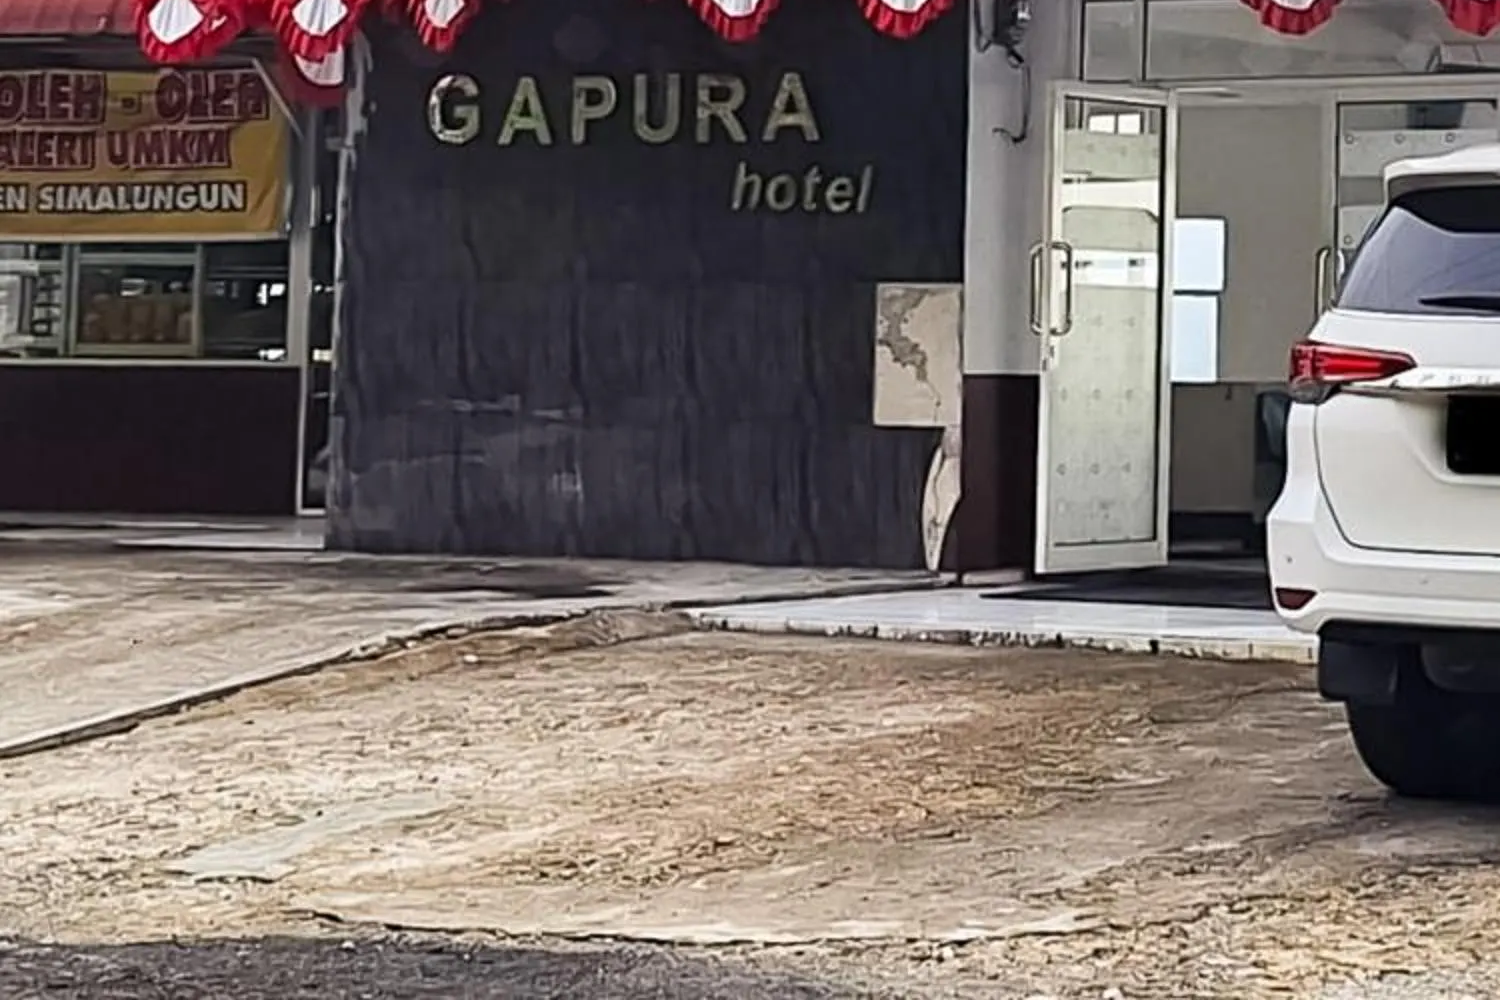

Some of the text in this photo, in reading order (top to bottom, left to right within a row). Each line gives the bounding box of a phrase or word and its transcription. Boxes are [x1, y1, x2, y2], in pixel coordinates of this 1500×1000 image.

[156, 72, 266, 119] OLEH
[428, 72, 821, 146] GAPURA
[106, 128, 230, 168] UMKM
[37, 182, 245, 212] SIMALUNGUN
[731, 161, 874, 213] hotel
